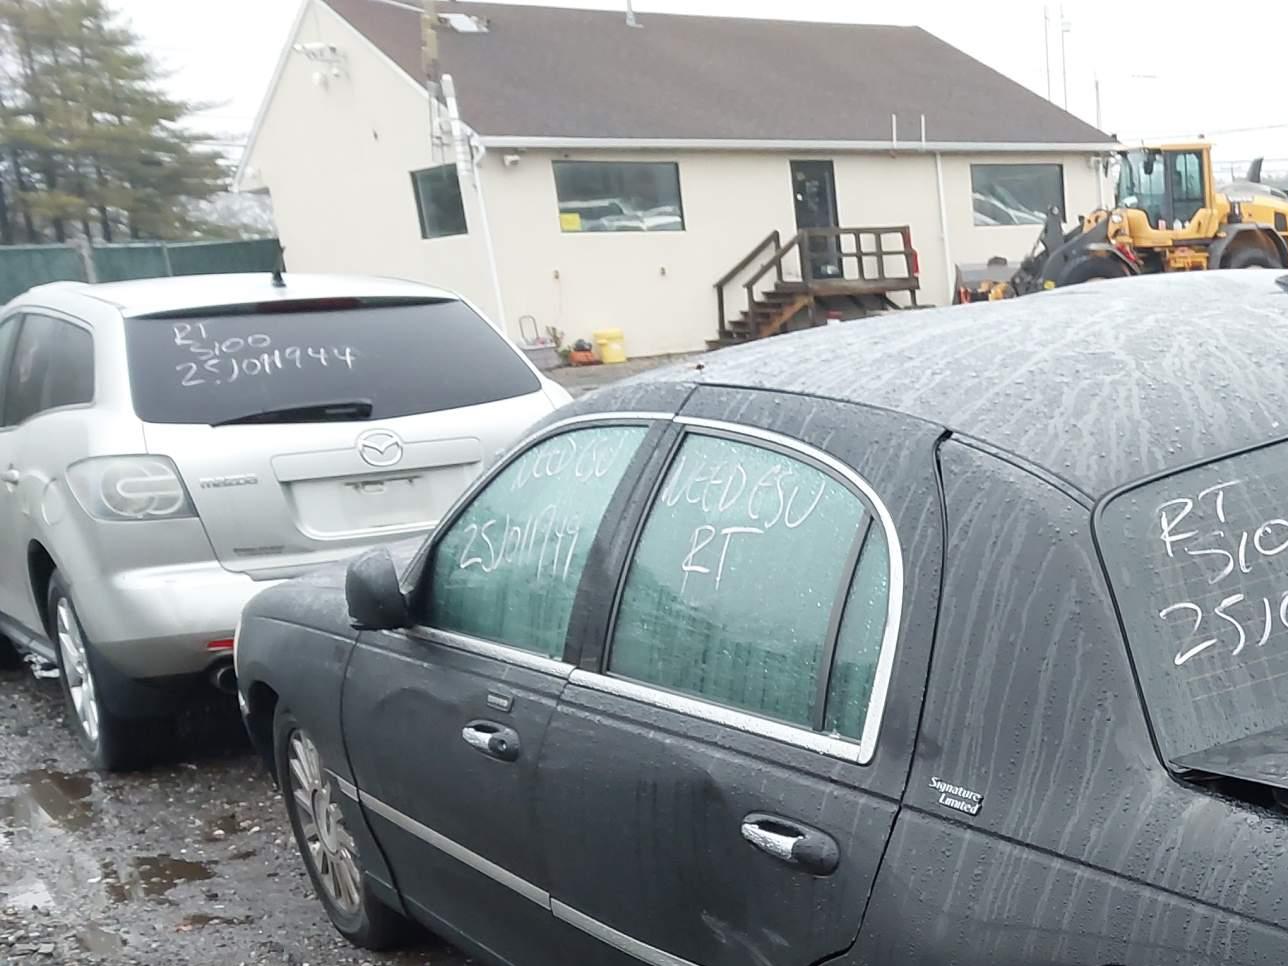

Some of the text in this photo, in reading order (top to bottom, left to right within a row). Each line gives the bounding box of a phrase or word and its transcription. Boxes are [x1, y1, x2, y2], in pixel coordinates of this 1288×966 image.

[1155, 479, 1244, 557] RT
[681, 525, 764, 594] RT
[928, 776, 981, 802] Signature
[939, 793, 981, 815] Limited
